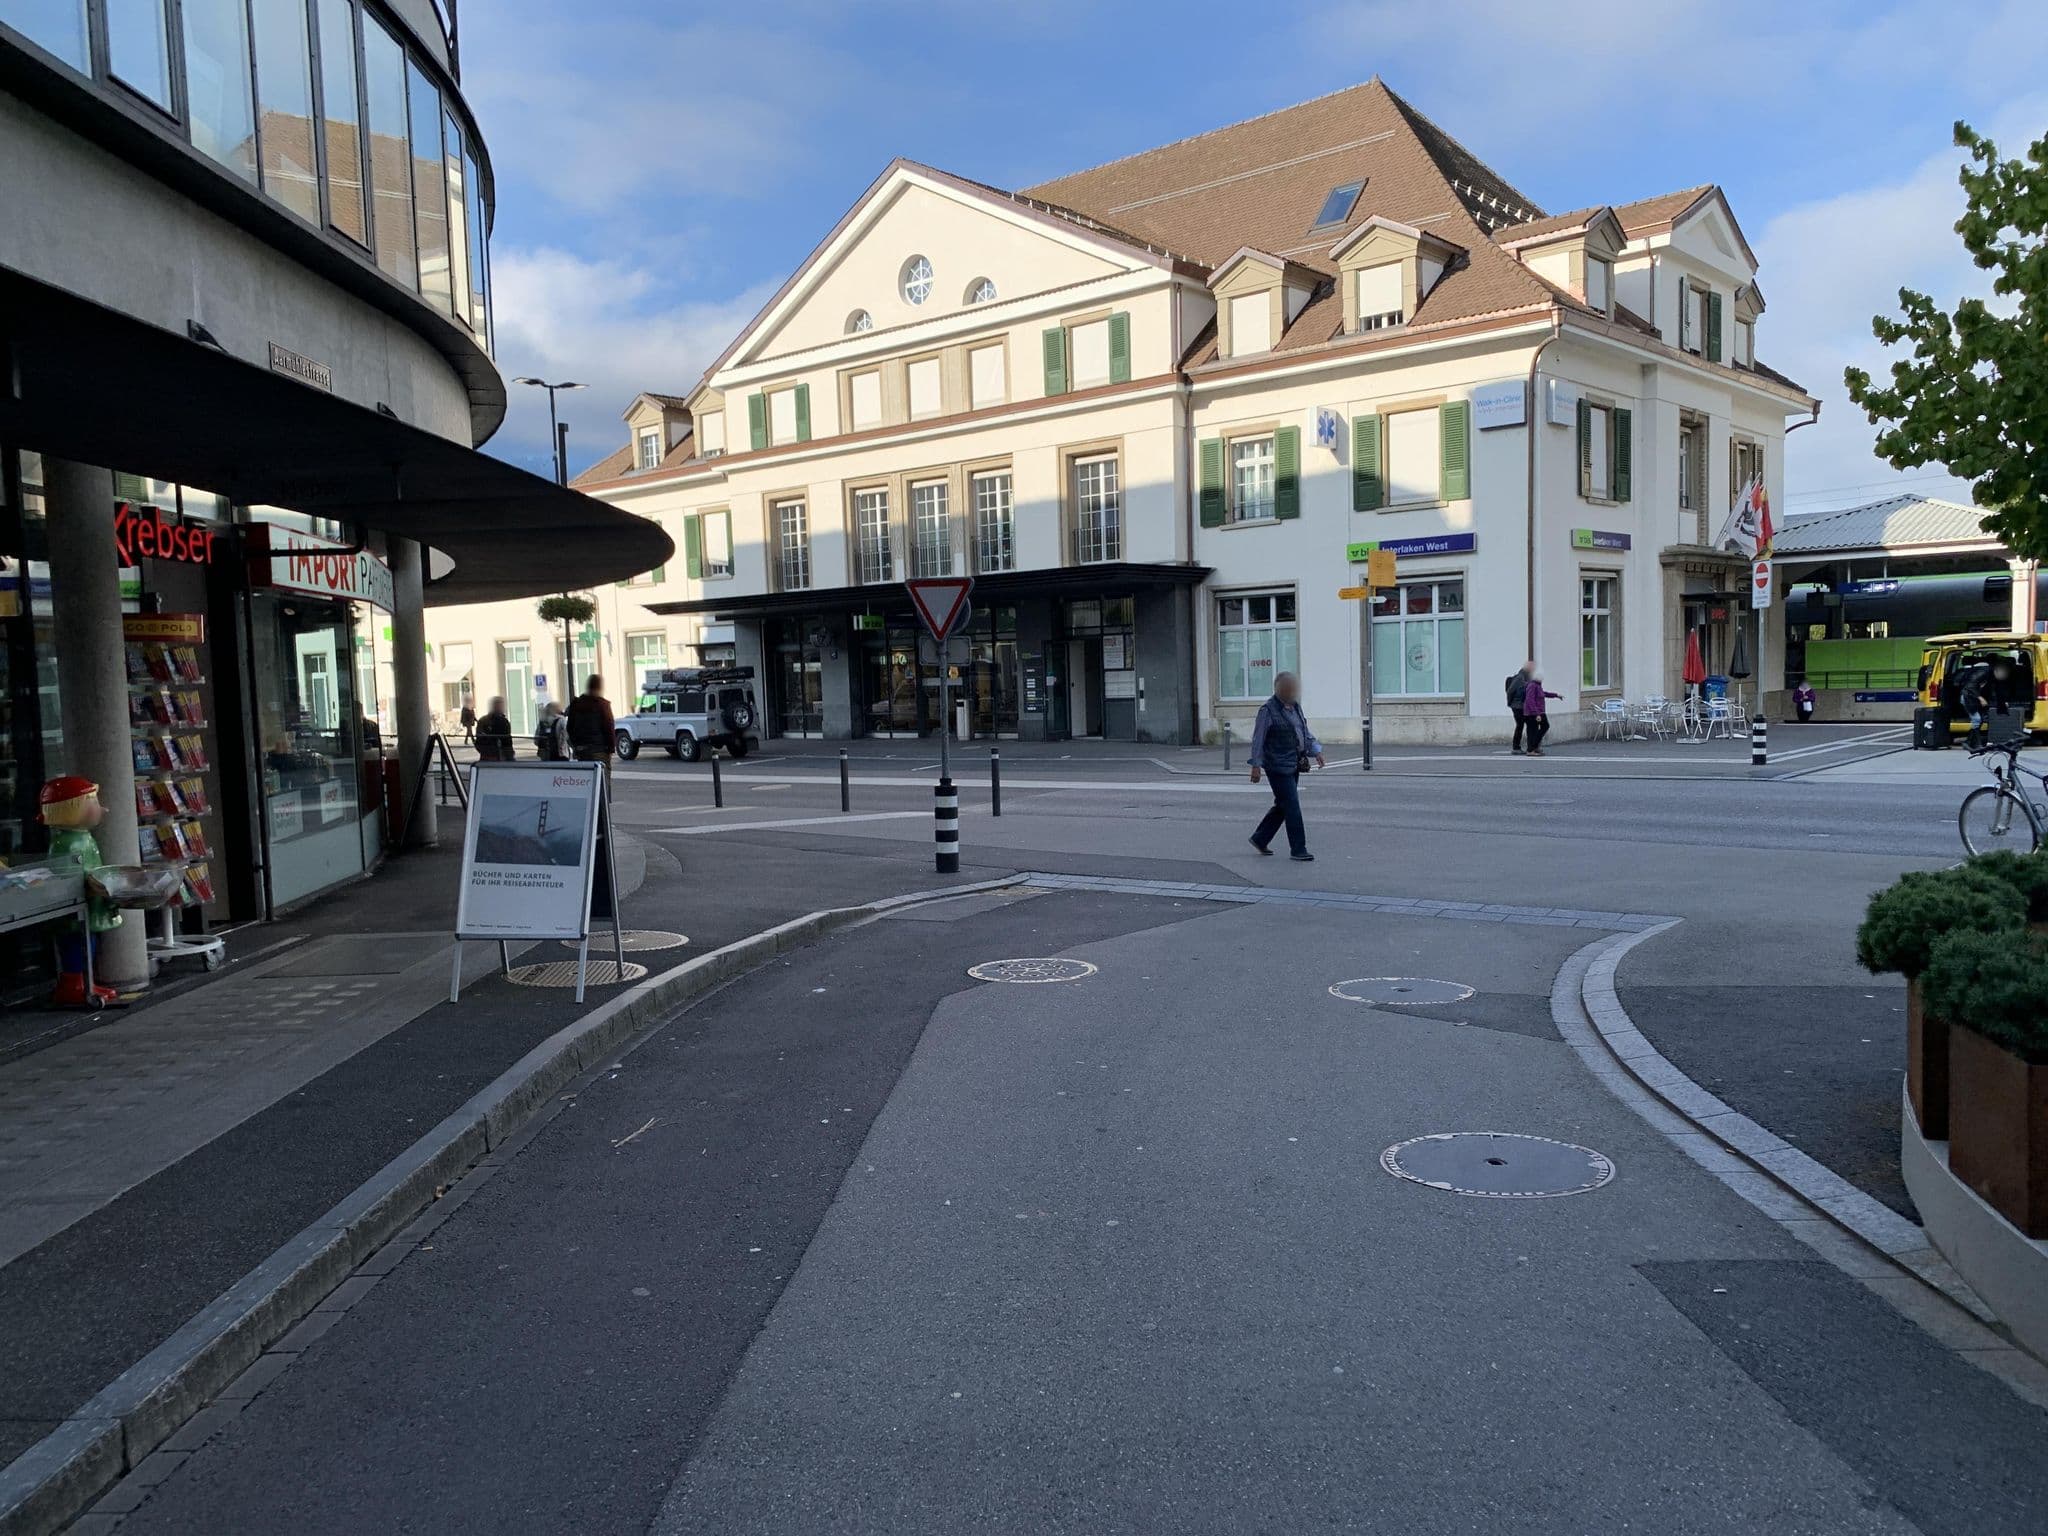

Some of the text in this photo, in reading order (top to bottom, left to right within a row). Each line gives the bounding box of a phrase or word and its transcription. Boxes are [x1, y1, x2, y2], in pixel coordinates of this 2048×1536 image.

[114, 503, 215, 567] Krebser
[1425, 542, 1448, 551] West
[288, 537, 357, 593] IMPORT
[161, 623, 192, 632] POLO
[1250, 659, 1273, 667] avec
[552, 775, 591, 788] Krebser
[472, 870, 552, 880] BÜCHER UND KARTEN
[471, 878, 486, 886] FÜR
[503, 880, 565, 889] REISEABENTEUER
